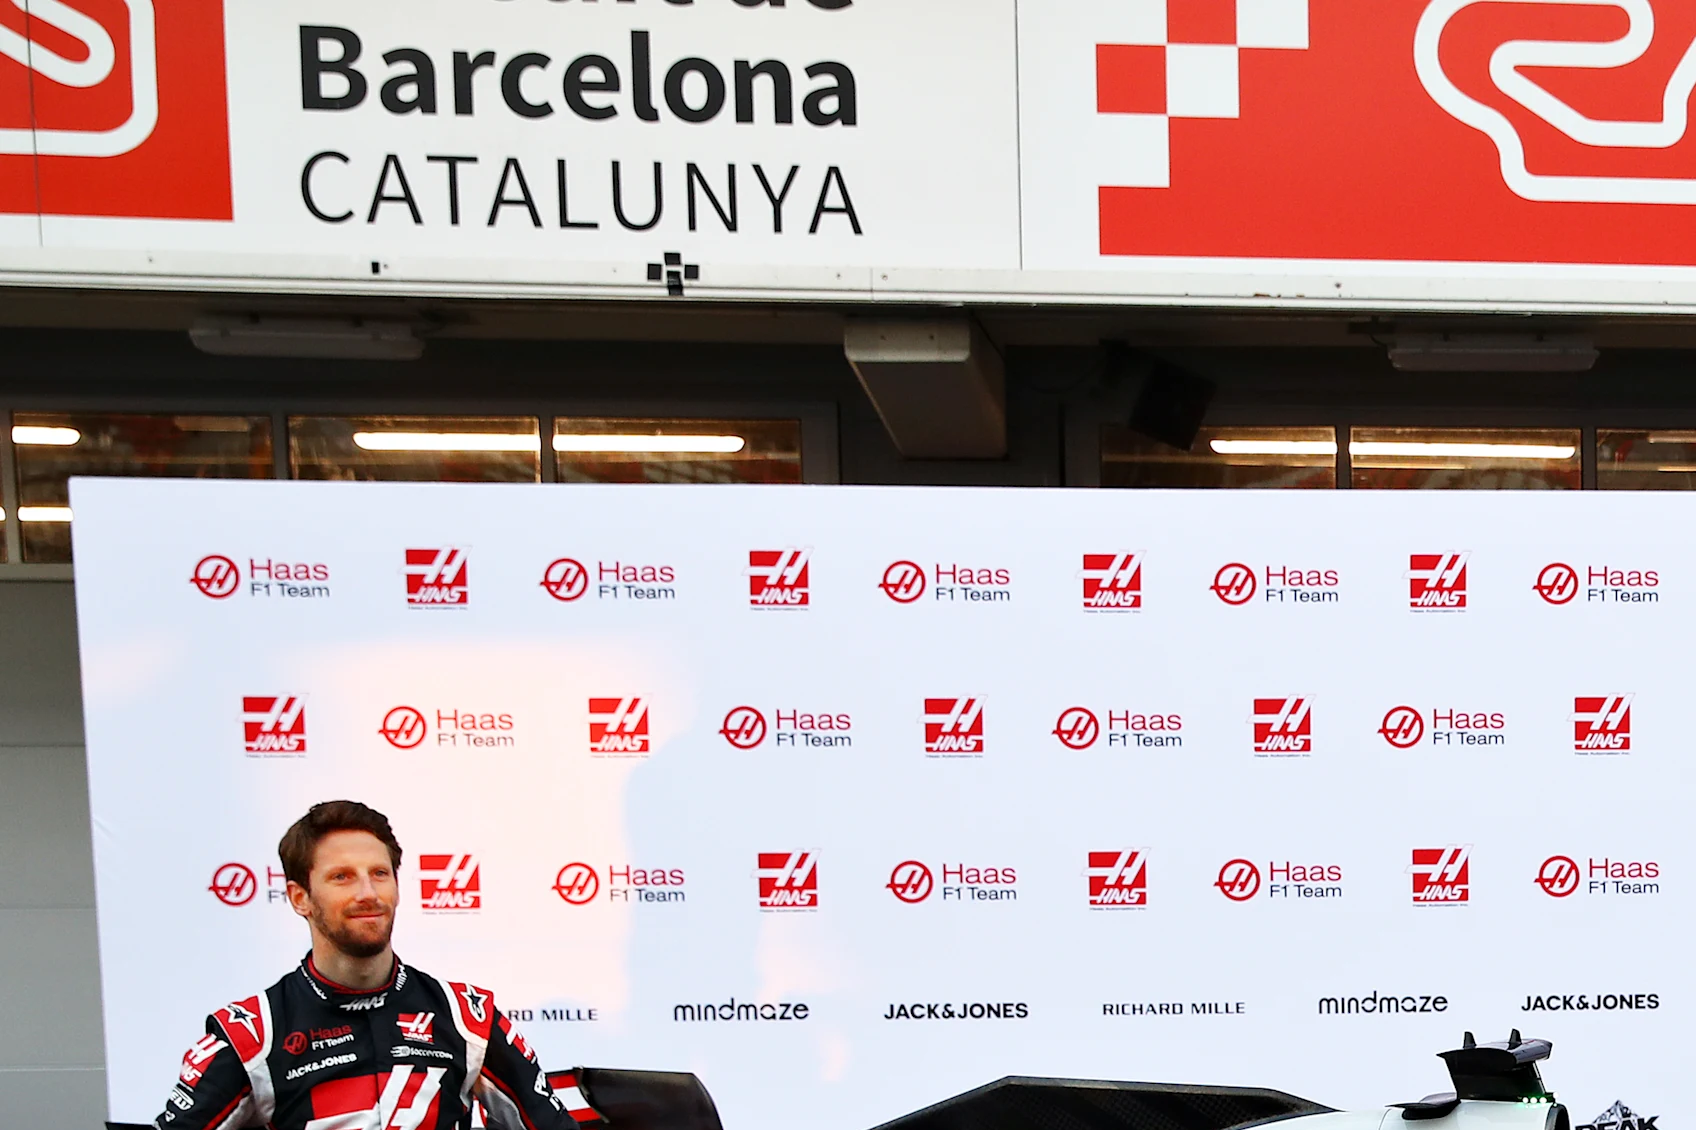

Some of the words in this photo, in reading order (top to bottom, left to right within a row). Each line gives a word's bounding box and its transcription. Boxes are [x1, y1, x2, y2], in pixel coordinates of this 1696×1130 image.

[298, 24, 858, 127] Barcelona
[301, 150, 863, 236] CATALUNYA
[250, 559, 329, 580] Haas
[599, 561, 674, 583] Haas
[936, 564, 1010, 585] Haas
[1266, 566, 1338, 587] Haas
[1588, 566, 1659, 587] Haas
[250, 583, 271, 597] F1
[276, 583, 330, 598] Team
[407, 586, 468, 603] HAAS
[598, 585, 618, 599] F1
[623, 585, 675, 600] Team
[748, 587, 810, 604] HAAS
[936, 587, 955, 601] F1
[959, 587, 1011, 602] Team
[1083, 590, 1142, 607] HAAS
[1266, 589, 1285, 603] F1
[1289, 589, 1339, 603] Team
[1410, 589, 1467, 606] HAAS
[1588, 589, 1606, 602] F1
[1610, 589, 1659, 603] Team
[437, 709, 513, 731] Haas
[776, 709, 851, 731] Haas
[1109, 710, 1182, 731] Haas
[1434, 708, 1504, 729] Haas
[242, 734, 307, 751] HAAS
[437, 733, 457, 747] F1
[463, 733, 514, 748] Team
[587, 734, 650, 751] HAAS
[776, 733, 796, 747] F1
[800, 733, 851, 748] Team
[924, 735, 984, 752] HAAS
[1109, 733, 1128, 747] F1
[1132, 733, 1182, 748] Team
[1253, 734, 1312, 751] HAAS
[1434, 732, 1453, 745] F1
[1457, 732, 1505, 746] Team
[1574, 732, 1631, 749] HAAS
[609, 865, 684, 886] Haas
[943, 863, 1016, 884] Haas
[1270, 861, 1341, 882] Haas
[1589, 858, 1659, 879] Haas
[609, 888, 629, 902] F1
[634, 888, 685, 903] Team
[943, 886, 962, 900] F1
[966, 886, 1017, 901] Team
[1088, 887, 1148, 904] HAAS
[1270, 884, 1289, 898] F1
[1293, 884, 1342, 899] Team
[1412, 884, 1470, 901] HAAS
[1589, 881, 1608, 894] F1
[1612, 881, 1659, 895] Team
[418, 891, 481, 908] HAAS
[758, 889, 818, 906] HAAS
[673, 997, 809, 1021] mindmaze
[1103, 1003, 1184, 1016] RICHARD
[1191, 1002, 1245, 1015] MILLE
[1318, 990, 1449, 1014] mindmaze
[1521, 993, 1660, 1011] JACK&JONES
[542, 1009, 597, 1021] MILLE
[884, 1003, 1028, 1020] JACK&JONES
[310, 1025, 352, 1039] Haas
[325, 1034, 354, 1048] Team
[286, 1053, 357, 1080] JACK&JONES
